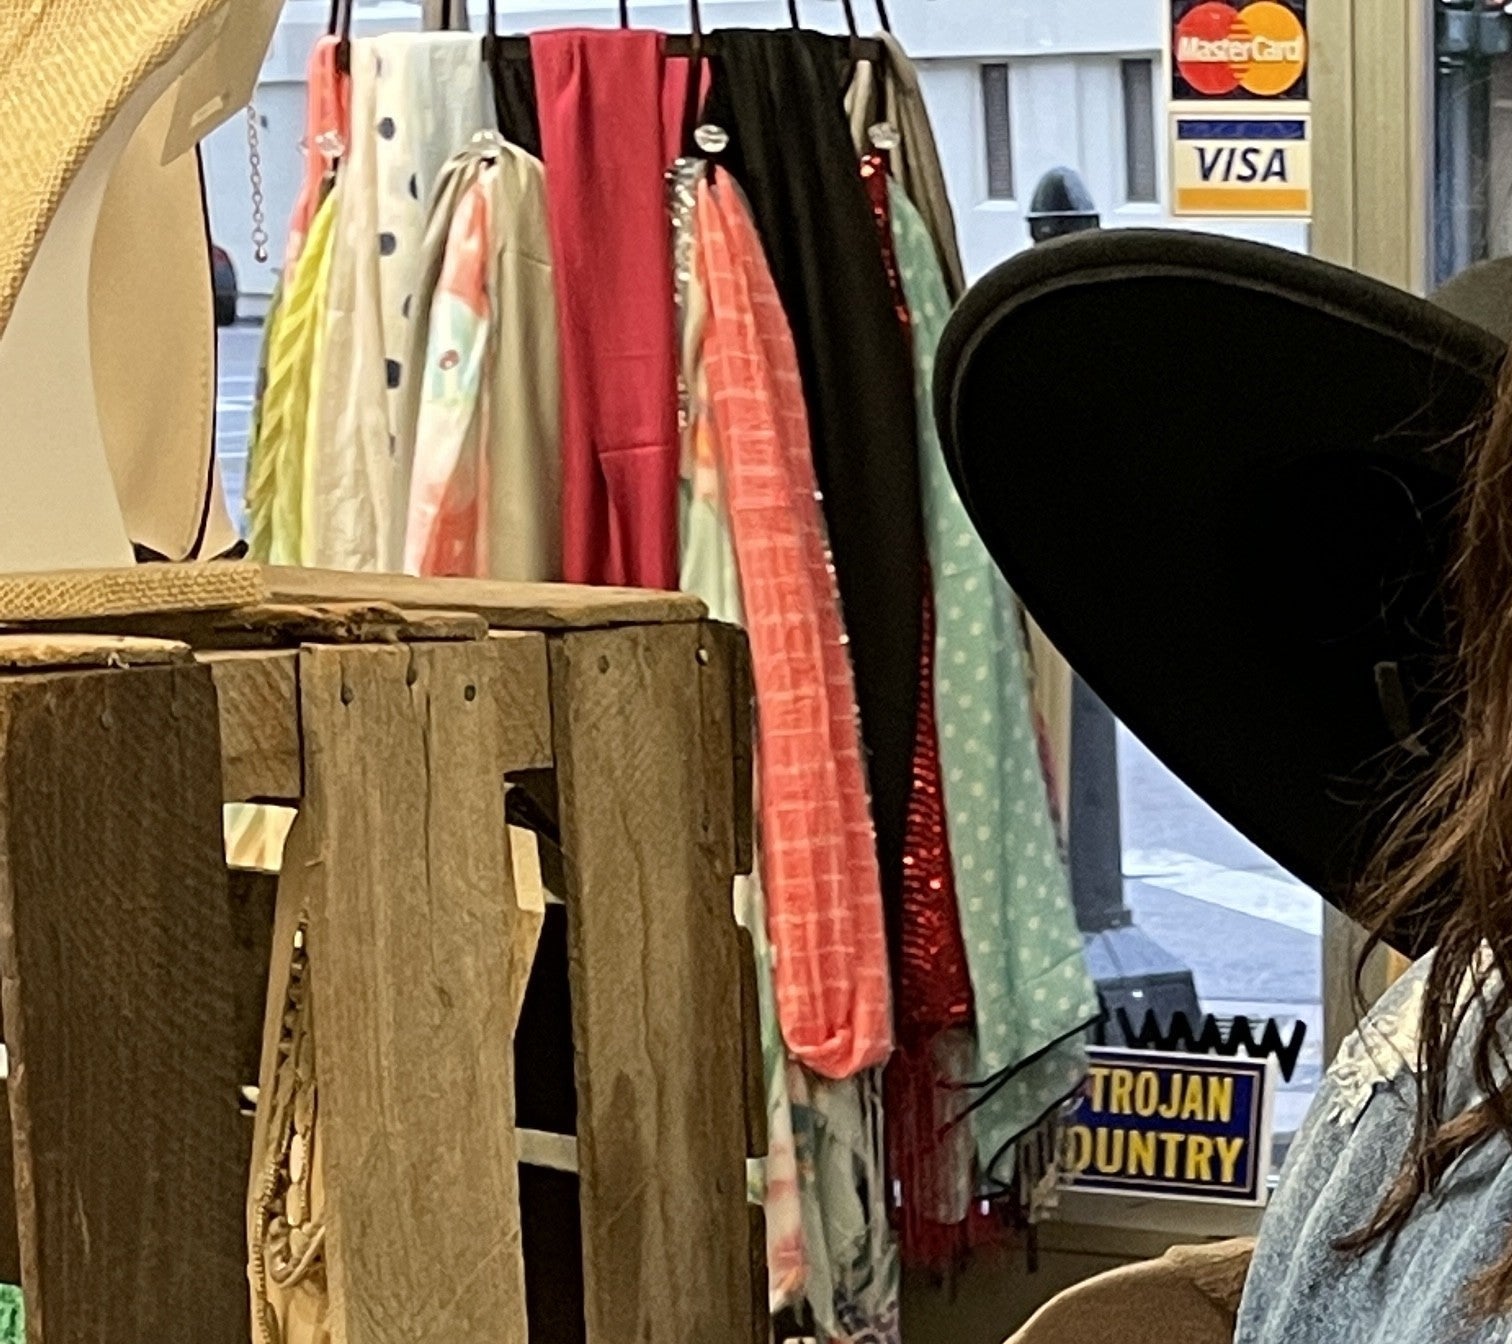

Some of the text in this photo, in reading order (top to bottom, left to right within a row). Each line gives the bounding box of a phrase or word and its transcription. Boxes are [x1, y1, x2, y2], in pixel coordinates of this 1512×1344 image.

[1177, 35, 1302, 62] MasterCard
[1194, 147, 1288, 182] VISA
[1089, 1067, 1233, 1122] TROJAN
[1064, 1125, 1244, 1183] OUNTRY
